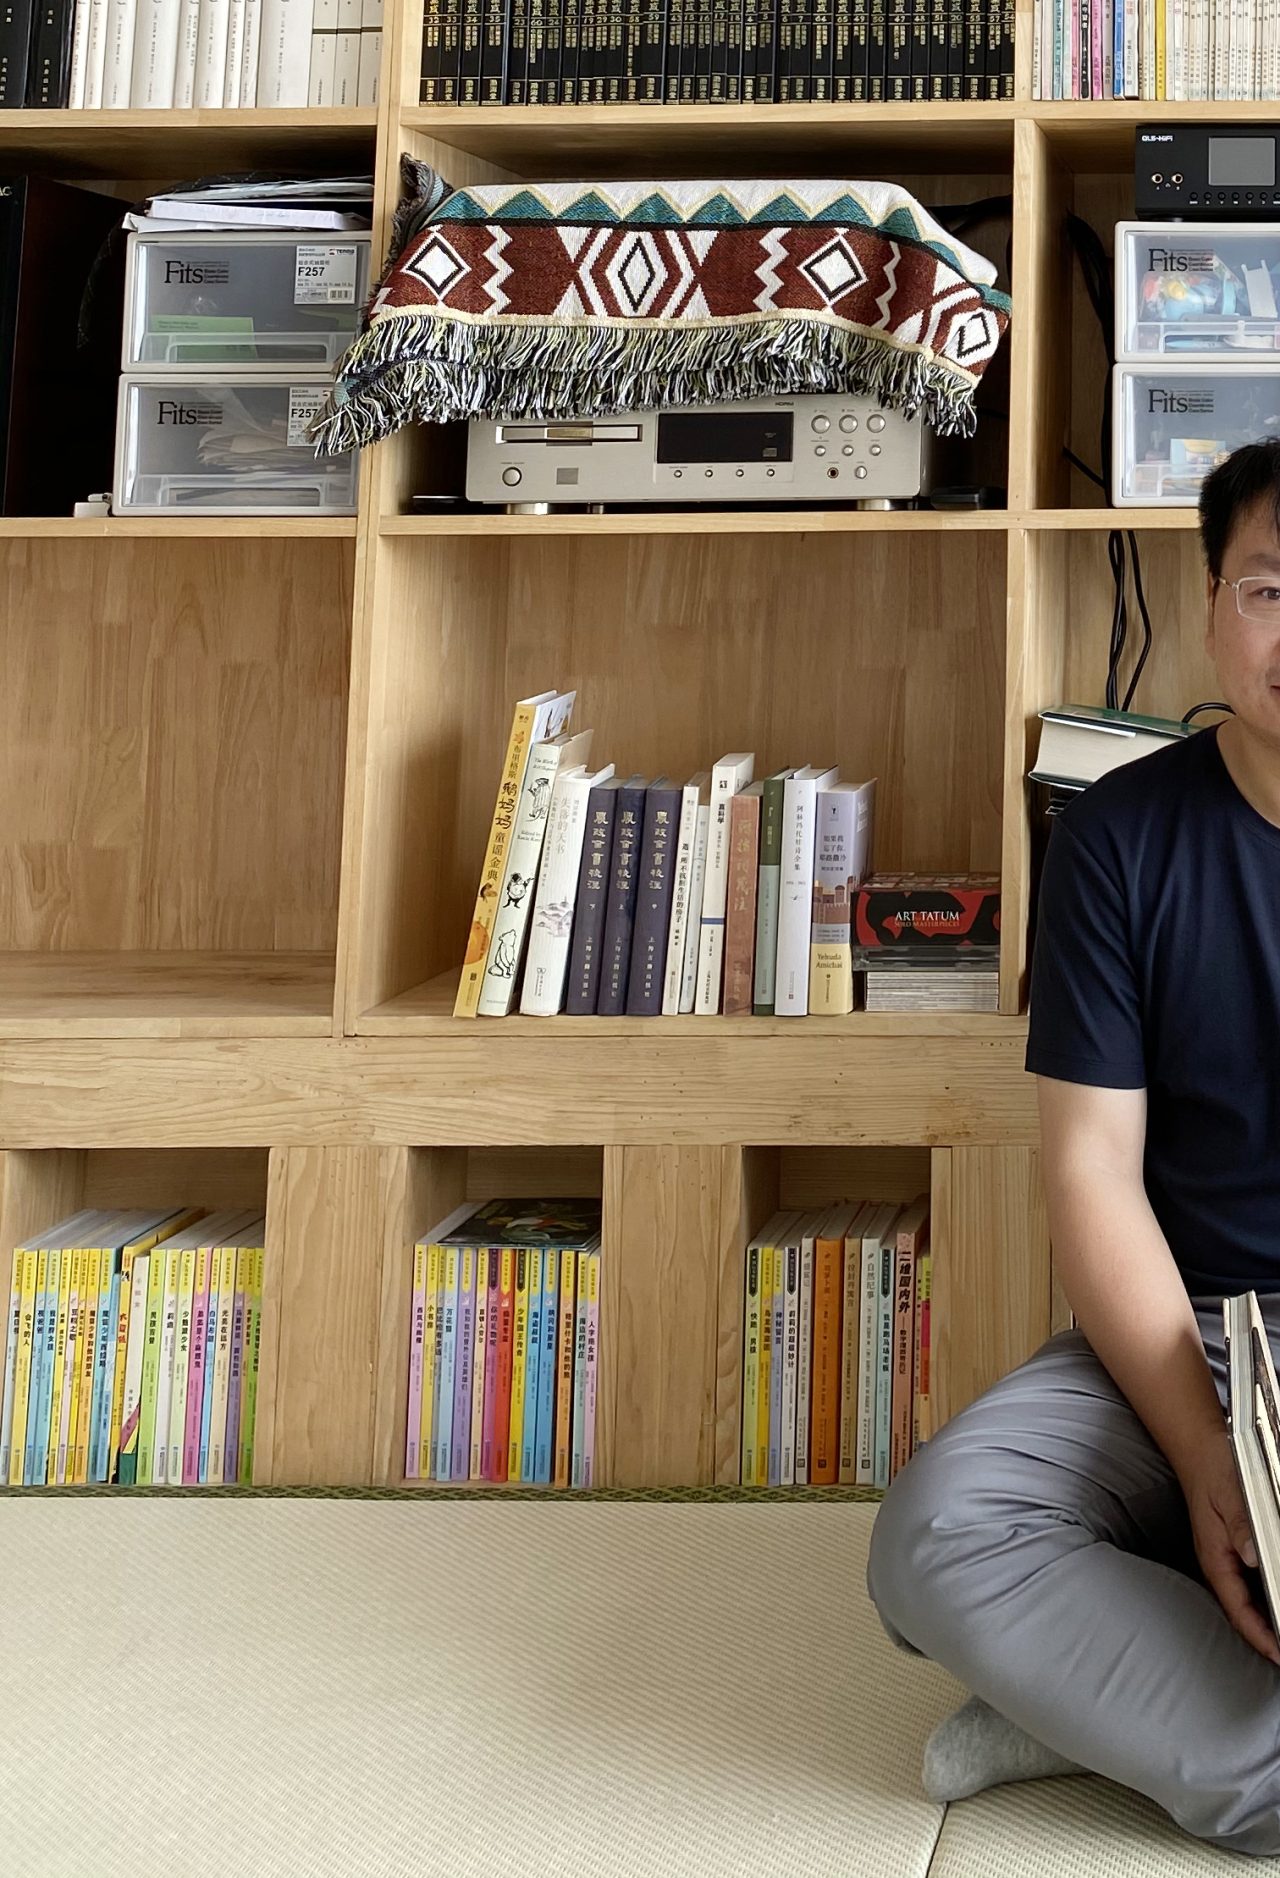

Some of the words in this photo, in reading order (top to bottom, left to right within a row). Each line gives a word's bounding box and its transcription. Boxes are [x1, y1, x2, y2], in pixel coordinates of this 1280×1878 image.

[165, 260, 204, 284] Fits
[298, 267, 325, 277] F257
[1148, 248, 1188, 272] Fits
[157, 401, 198, 425] Fits
[291, 408, 319, 418] F257
[1148, 389, 1189, 413] Fits
[820, 854, 847, 862] 耶路撒冷
[895, 911, 917, 921] ART
[920, 911, 959, 921] TATUM
[816, 961, 843, 969] Amichai
[866, 1262, 875, 1300] 自然纪事
[897, 1250, 913, 1314] 二维国内外
